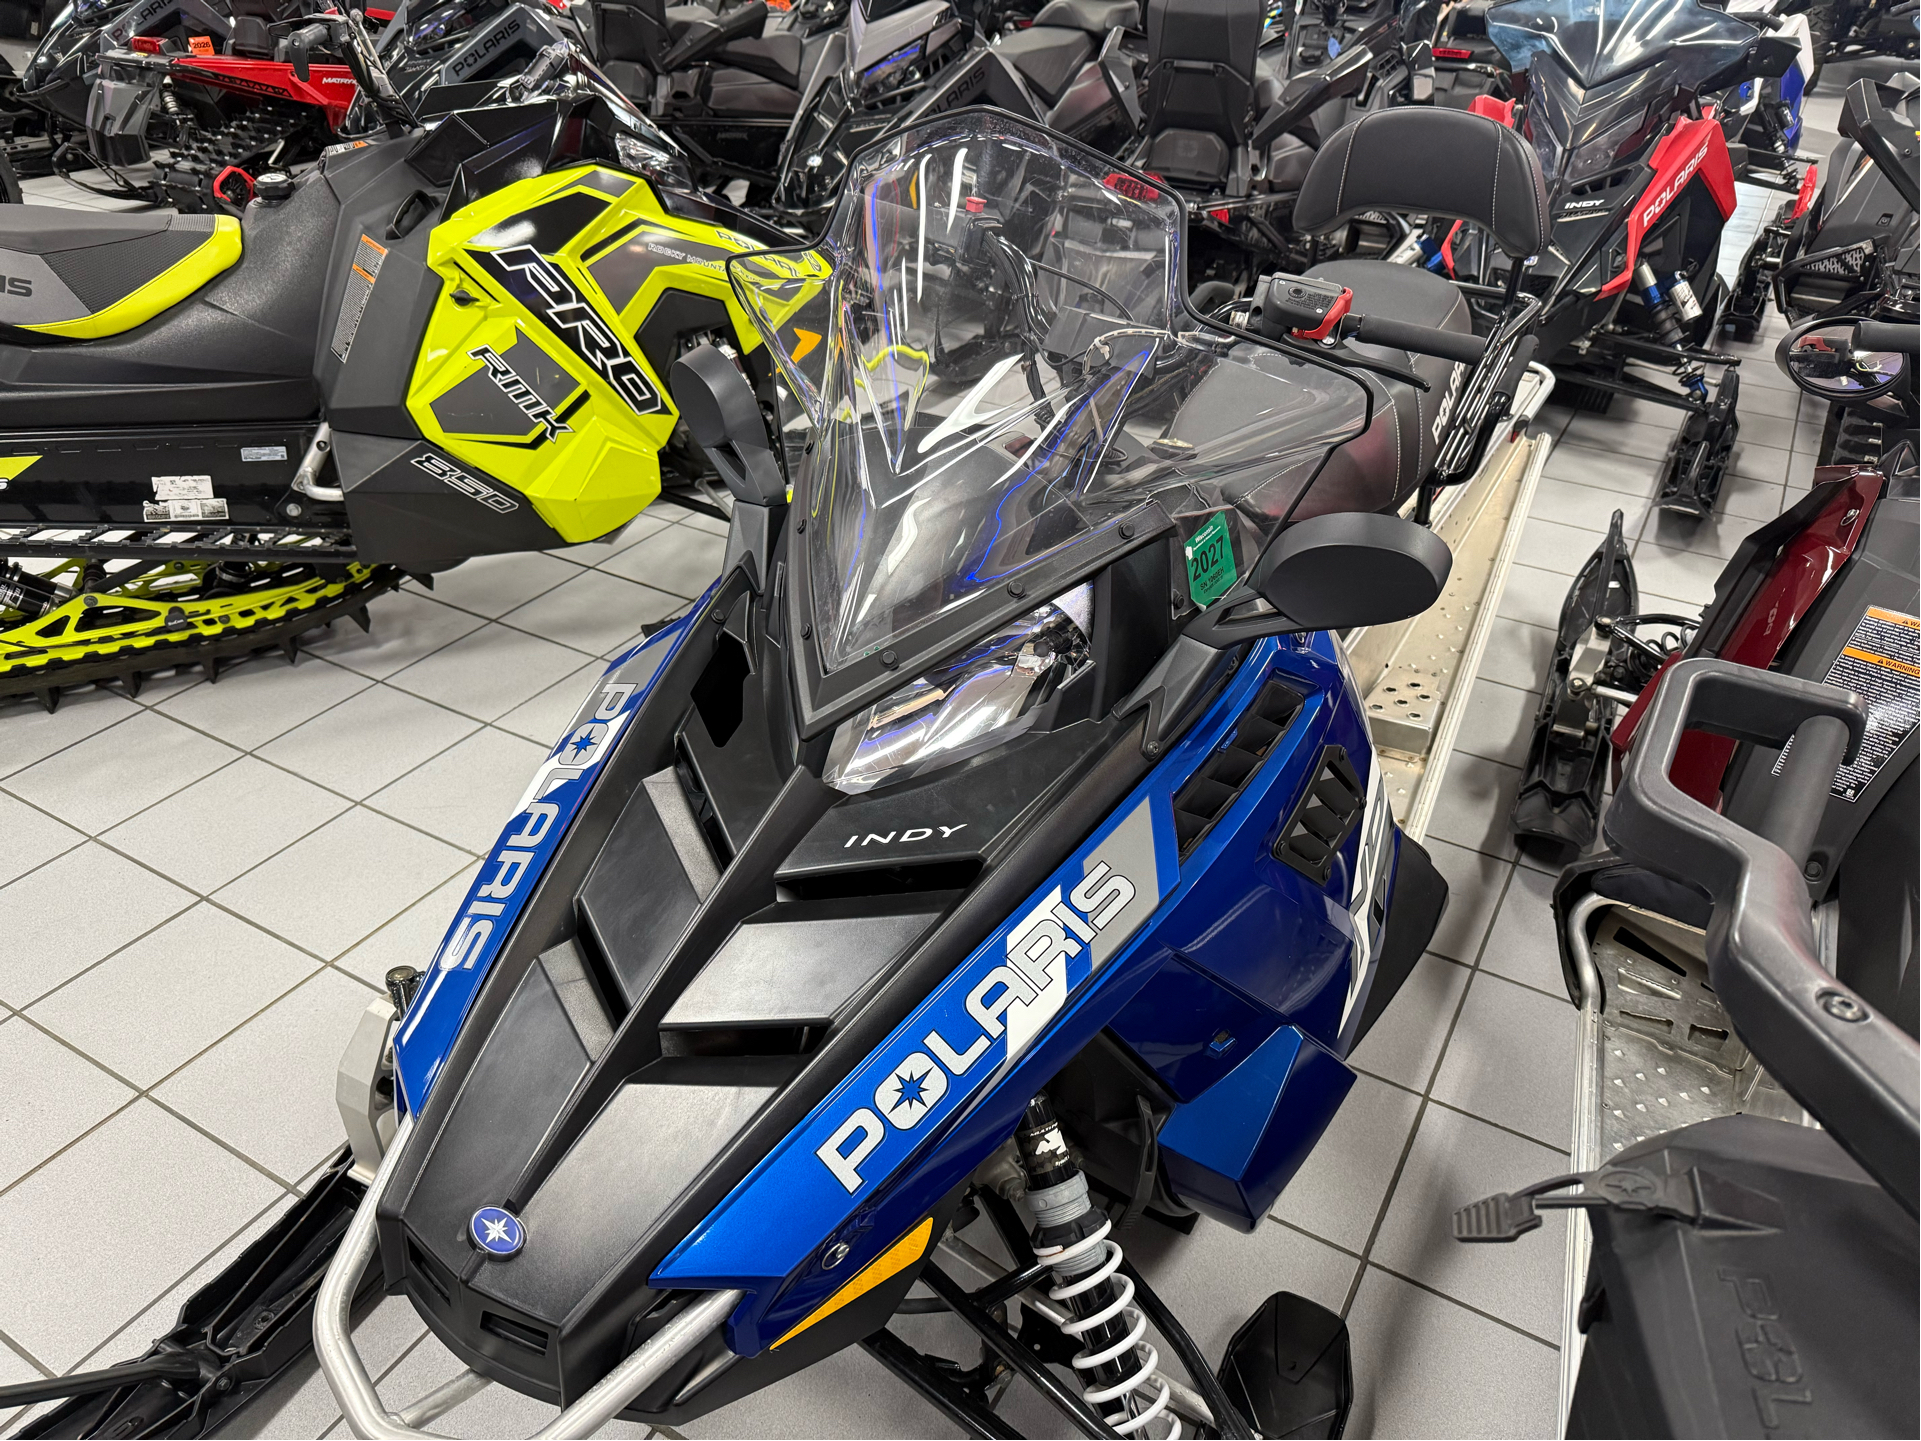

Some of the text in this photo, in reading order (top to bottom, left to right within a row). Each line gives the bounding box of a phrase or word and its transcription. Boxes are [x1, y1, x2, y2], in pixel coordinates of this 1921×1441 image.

[452, 19, 521, 77] POLARIS
[925, 66, 986, 118] LARIS
[1564, 199, 1605, 209] INDY
[1643, 144, 1709, 227] POLARIS
[648, 242, 685, 260] ROCKY
[490, 244, 662, 416] PRO
[467, 344, 574, 443] RMK
[410, 453, 519, 513] 850
[1191, 535, 1223, 582] 2027
[1885, 660, 1920, 675] WARNING
[438, 682, 638, 970] POLARIS
[844, 823, 968, 848] INDY
[814, 860, 1137, 1195] POLARIS
